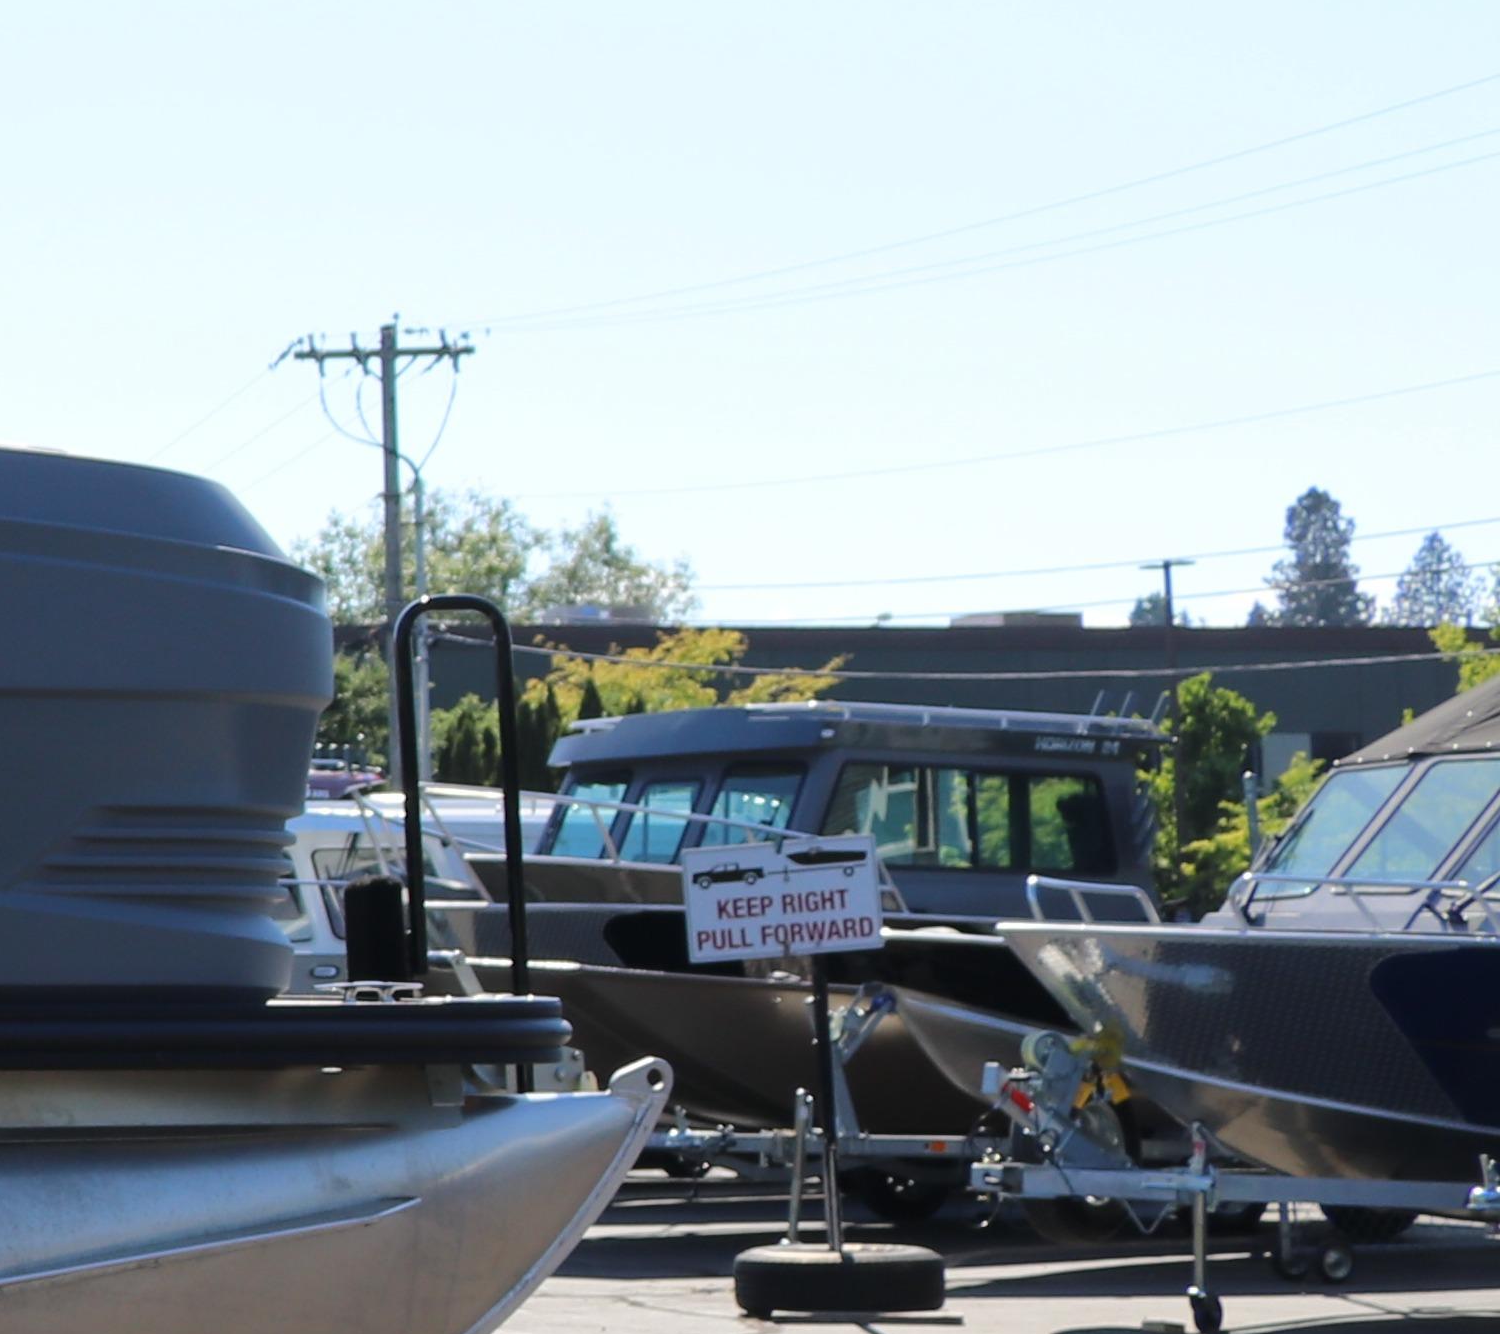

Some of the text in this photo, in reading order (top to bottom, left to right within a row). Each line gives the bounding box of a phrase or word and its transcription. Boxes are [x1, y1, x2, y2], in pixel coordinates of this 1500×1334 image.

[717, 889, 848, 919] KEEP RIGHT
[697, 917, 874, 951] PULL FORWARD
